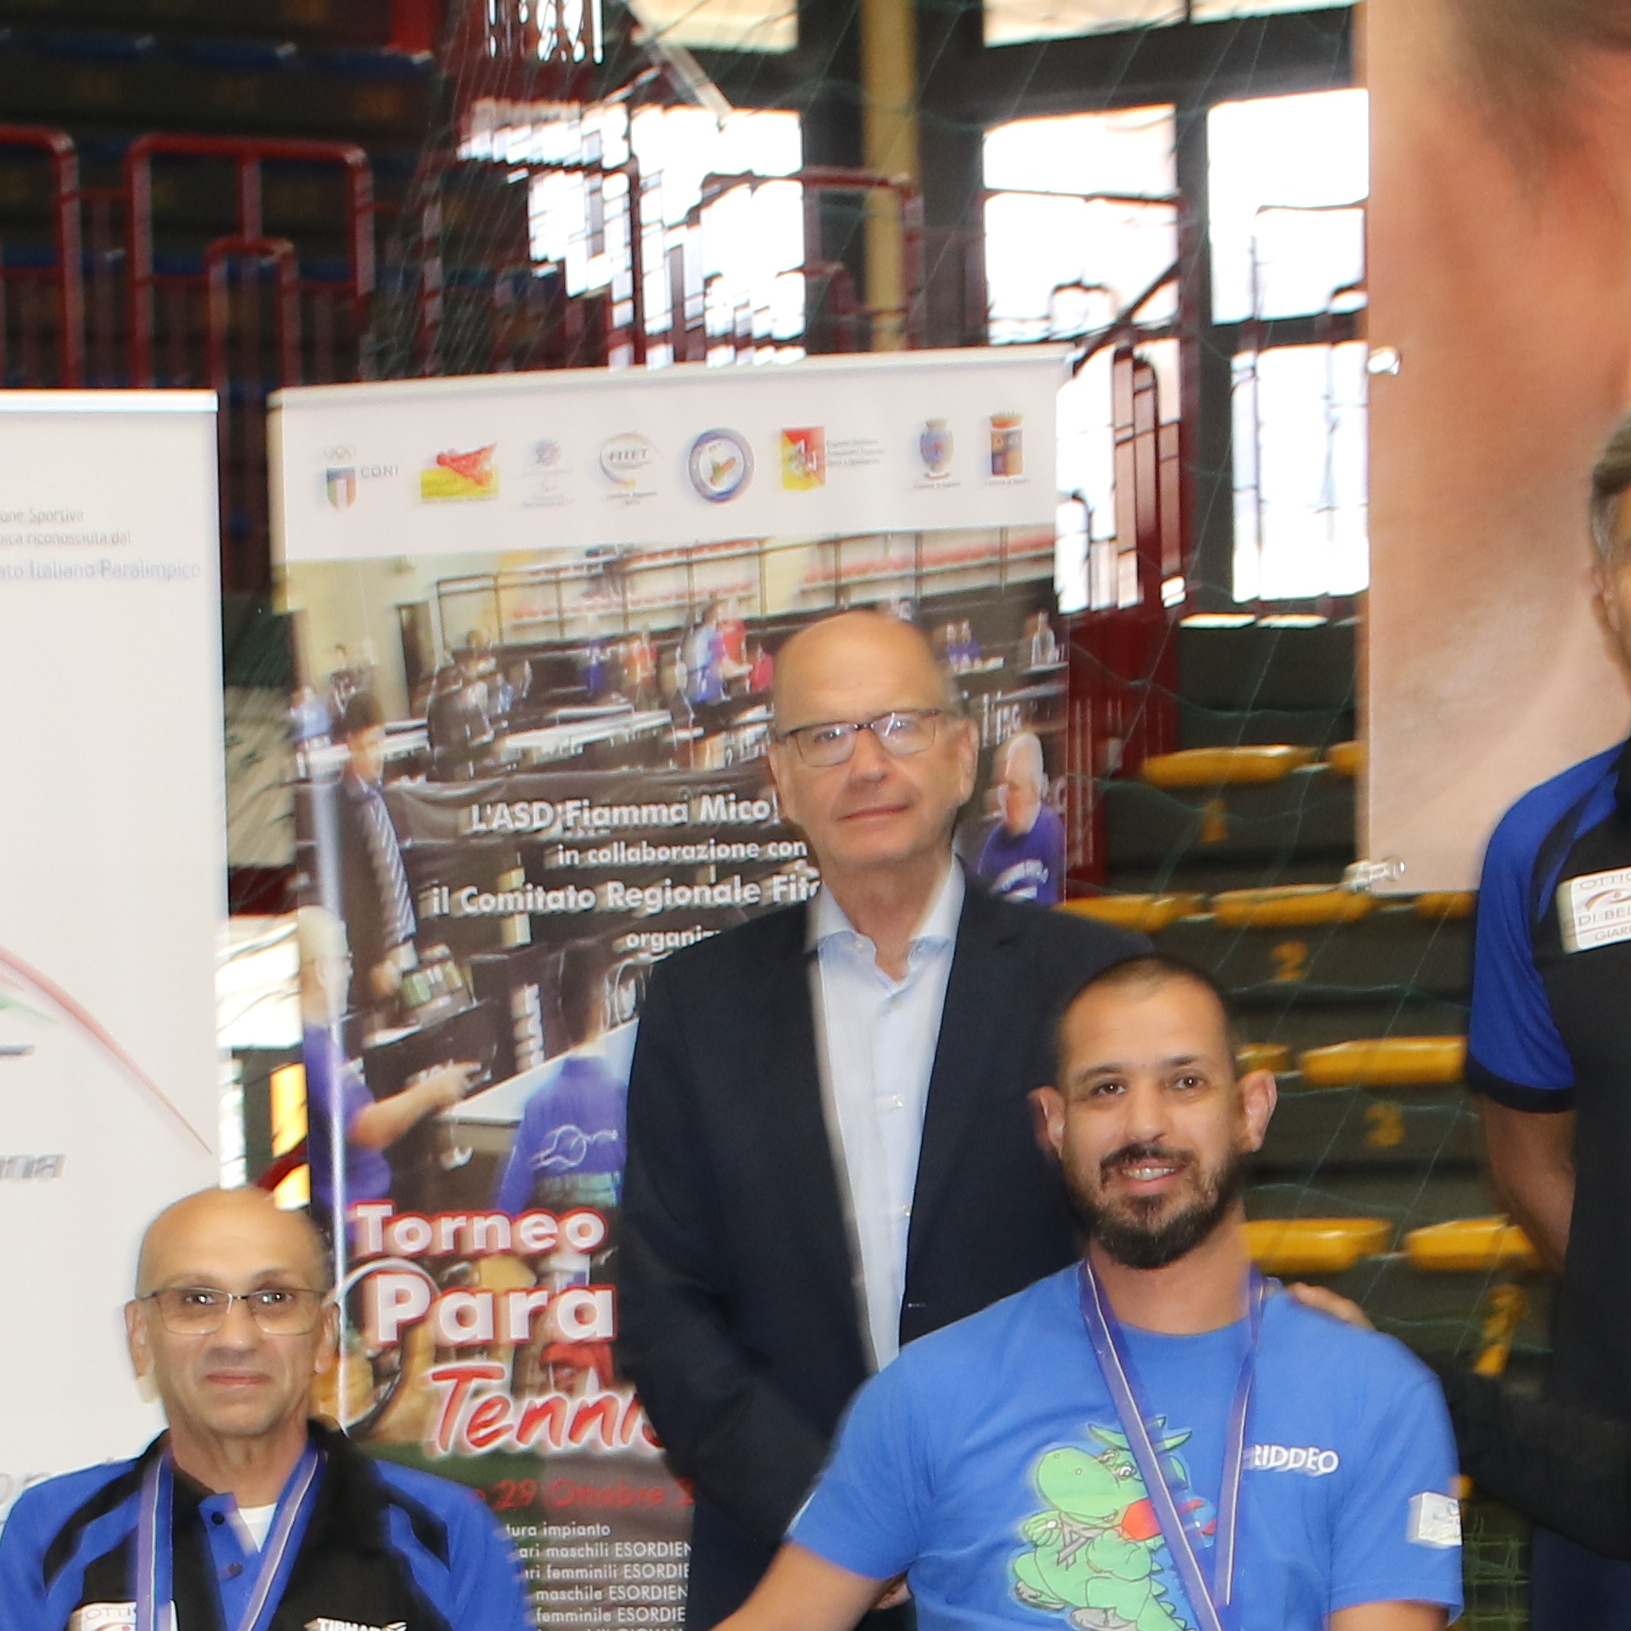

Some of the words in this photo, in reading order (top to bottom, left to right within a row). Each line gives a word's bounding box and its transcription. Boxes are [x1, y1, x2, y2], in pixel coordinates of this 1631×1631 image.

[29, 506, 86, 526] Sportiva
[26, 530, 107, 546] riconosciuta
[29, 558, 97, 580] Italiano
[100, 558, 201, 582] Paralimpico
[565, 799, 689, 829] Fiamma
[557, 844, 580, 865] in
[587, 839, 761, 865] collaborazione
[767, 840, 809, 858] con
[432, 881, 450, 915] il
[460, 884, 597, 915] Comitato
[606, 875, 762, 917] Regionale
[353, 1203, 606, 1254] Torneo
[375, 1273, 616, 1344] Para
[543, 1521, 611, 1539] impianto
[546, 1542, 608, 1558] maschili
[547, 1563, 617, 1579] femminili
[535, 1585, 602, 1601] maschile
[536, 1607, 611, 1622] femminile
[618, 1606, 686, 1622] ESORDIE
